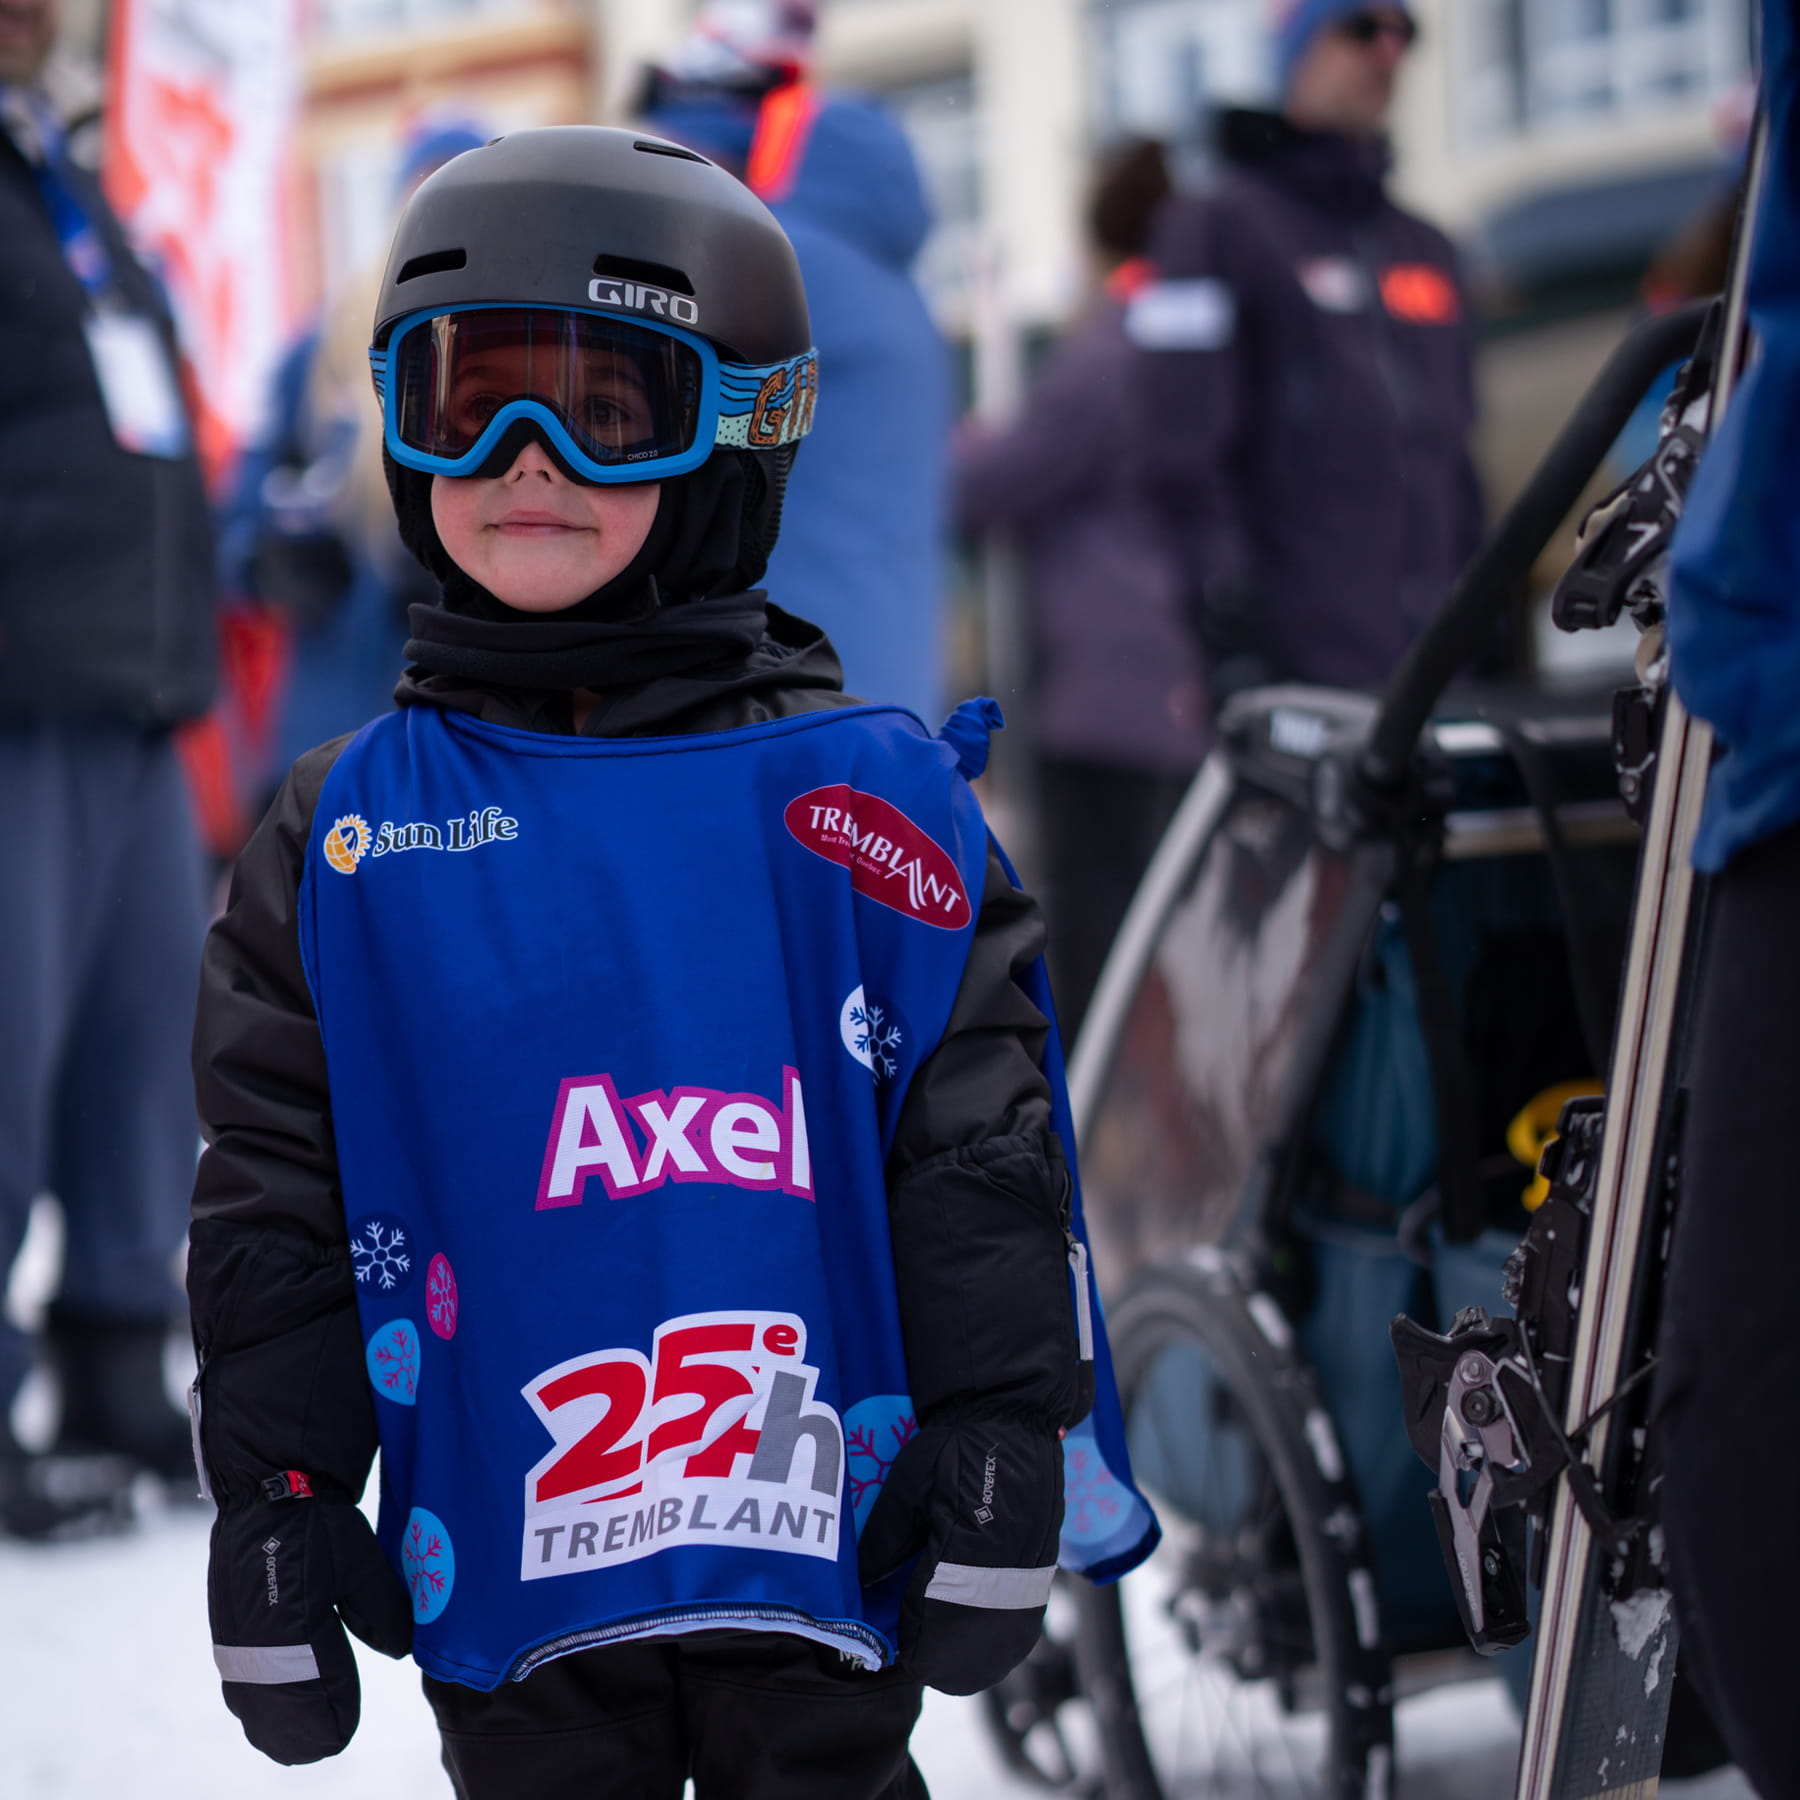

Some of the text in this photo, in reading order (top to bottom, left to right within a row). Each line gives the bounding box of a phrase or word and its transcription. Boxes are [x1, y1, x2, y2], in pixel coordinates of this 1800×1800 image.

[589, 278, 698, 325] GIRO
[372, 806, 518, 857] Sun Life
[809, 804, 961, 913] TREMBLANT
[545, 1074, 812, 1200] Axel
[535, 1494, 835, 1563] TREMBLANT
